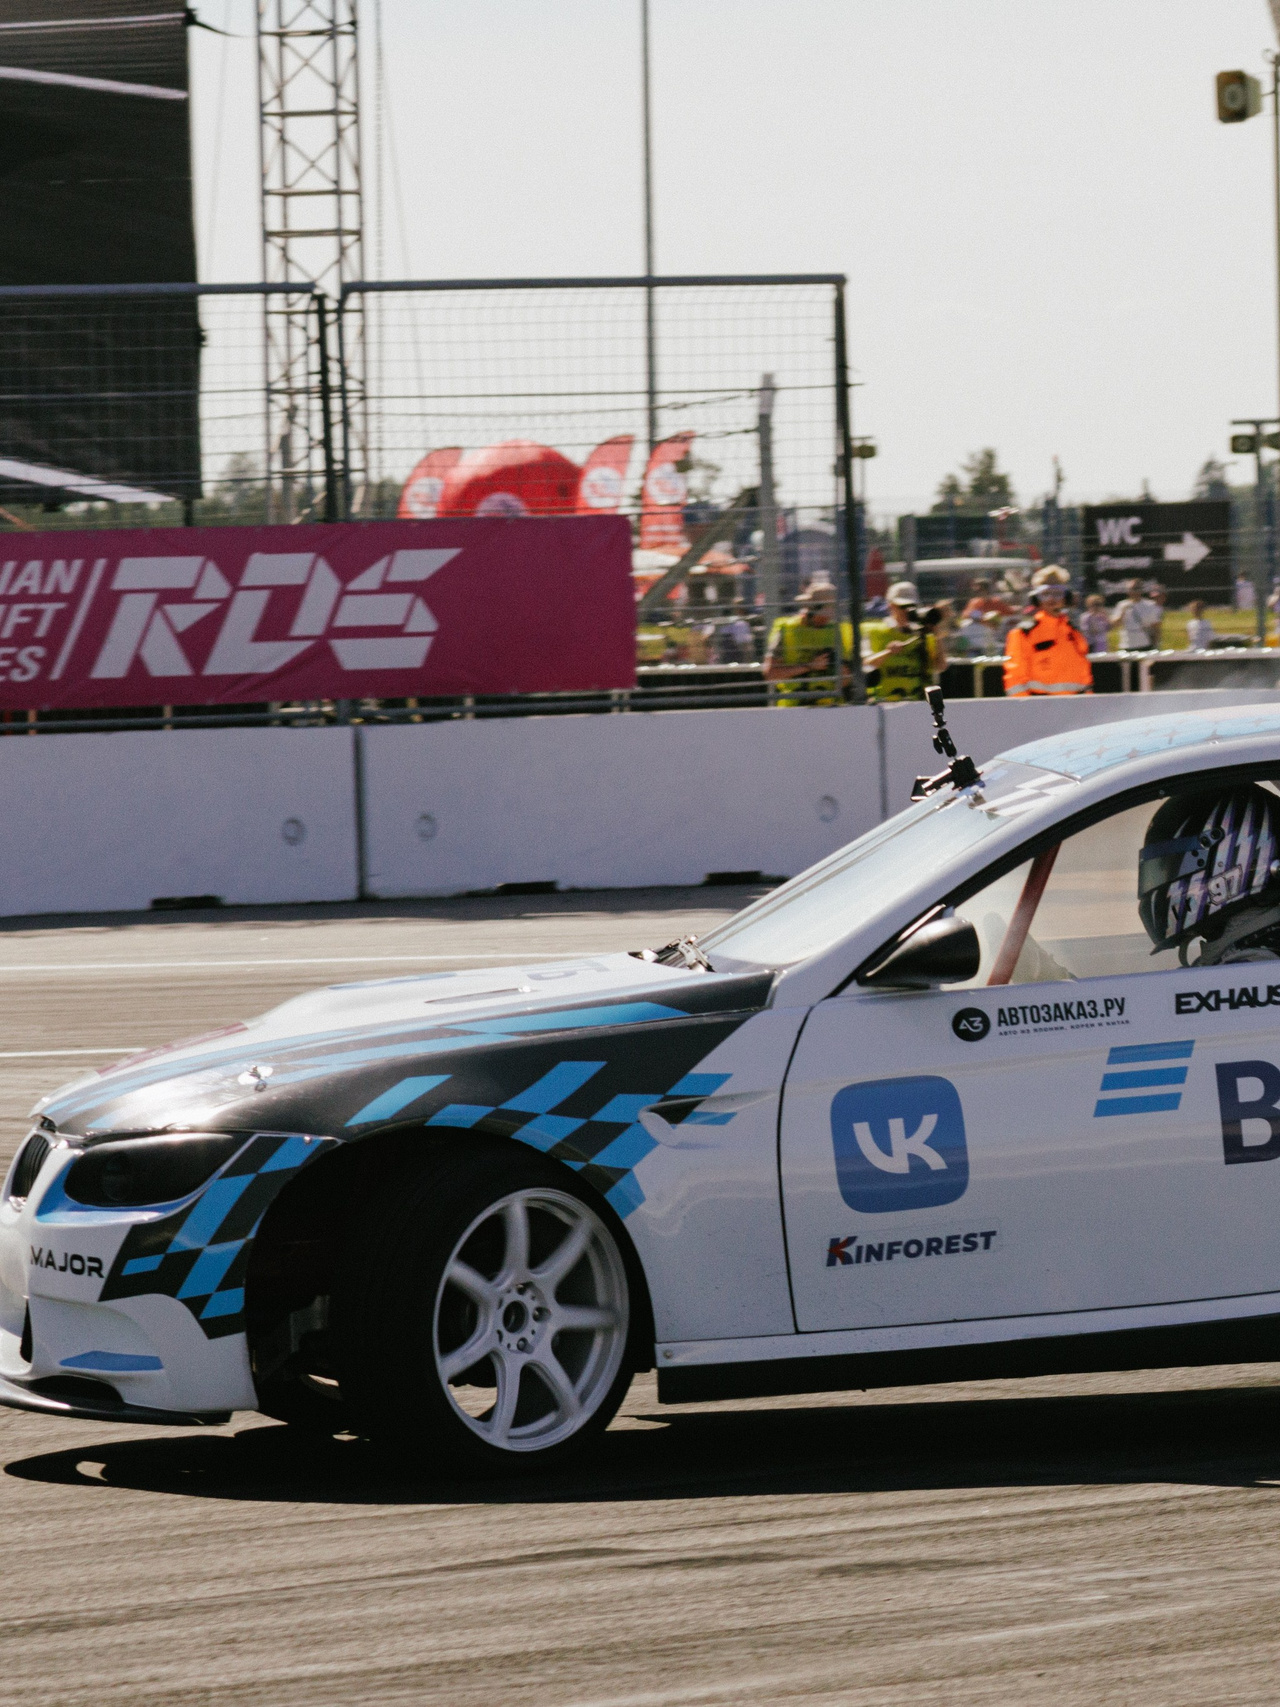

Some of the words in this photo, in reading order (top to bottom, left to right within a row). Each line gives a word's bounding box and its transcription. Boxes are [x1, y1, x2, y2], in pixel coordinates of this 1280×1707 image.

[1096, 516, 1142, 546] WC
[0, 602, 68, 639] FT
[90, 547, 464, 679] RDS
[997, 997, 1126, 1027] АВТОЗАКАЗ.РУ
[852, 1113, 949, 1175] VK
[30, 1244, 105, 1279] MAJOR
